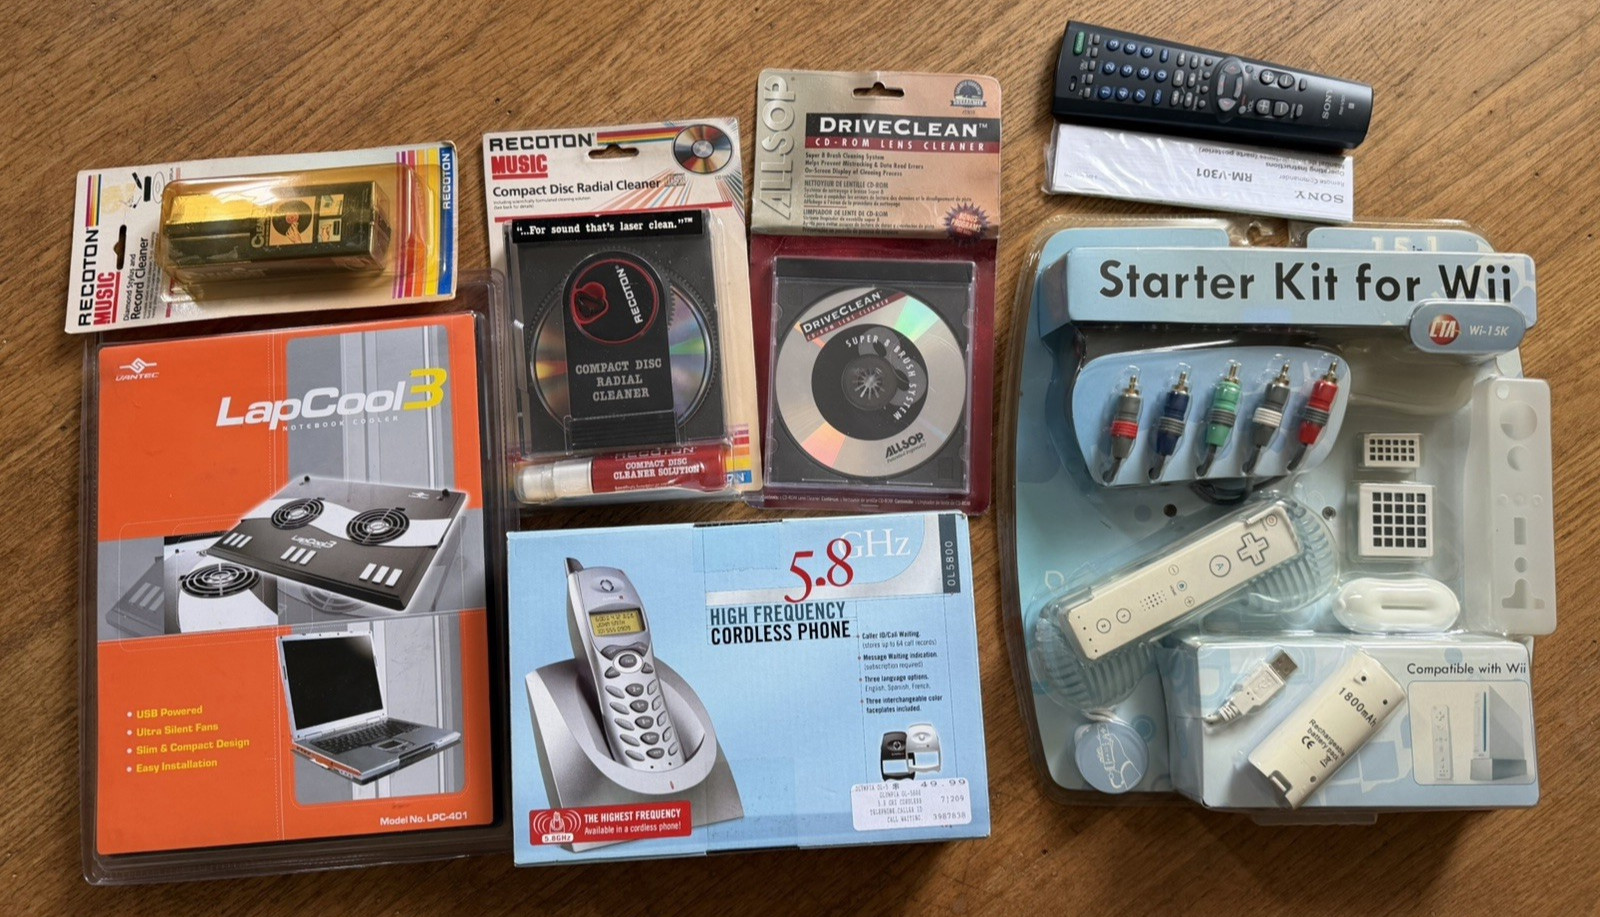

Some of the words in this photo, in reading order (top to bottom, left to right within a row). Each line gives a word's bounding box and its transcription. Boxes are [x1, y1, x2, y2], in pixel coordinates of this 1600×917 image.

[490, 132, 592, 152] RECOTON
[760, 75, 796, 220] ALLSOP
[880, 139, 913, 150] LENS
[923, 140, 985, 152] CLEANER
[491, 154, 548, 174] MUSIC
[832, 168, 852, 176] Display
[1265, 161, 1308, 172] Instructions
[1308, 165, 1345, 177] Operating
[442, 153, 451, 210] RECOTON
[1196, 167, 1253, 183] RM-V301
[1279, 174, 1319, 185] Commander
[492, 182, 547, 198] Compact
[550, 180, 574, 195] Disc
[577, 178, 614, 193] Radial
[616, 178, 662, 191] Cleaner
[1321, 180, 1345, 188] Remote
[1294, 190, 1344, 204] SONY
[551, 222, 580, 234] sound
[586, 221, 615, 232] that's
[620, 220, 643, 232] laser
[136, 237, 149, 279] Cleaner
[78, 228, 99, 326] RECOTON
[126, 265, 135, 289] Stylus
[1099, 259, 1255, 300] Starter
[1275, 262, 1338, 301] Kit
[1356, 263, 1420, 302] for
[1438, 264, 1512, 303] Wii
[93, 272, 115, 326] MUSIC
[130, 282, 145, 320] Record
[616, 267, 644, 324] RECOTON
[122, 290, 133, 322] Diamond
[1469, 325, 1510, 337] Wi-15K
[845, 334, 880, 348] SUPER
[575, 360, 630, 375] COMPACT
[635, 358, 662, 370] DISC
[893, 345, 917, 378] BRUSH
[115, 372, 160, 382] VANTEC
[596, 374, 643, 388] RADIAL
[216, 368, 448, 430] LapCool3
[592, 388, 650, 402] CLEANER
[892, 382, 917, 421] SYSTEM
[282, 420, 346, 432] NOTEBOOK
[352, 416, 399, 426] COOLER
[885, 432, 924, 459] ALLSOP
[613, 468, 656, 480] CLEANER
[658, 464, 700, 477] SOLUTION
[625, 459, 665, 470] COMPACT
[668, 458, 688, 466] DISC
[784, 537, 854, 604] 5.8
[837, 528, 911, 559] GHz
[944, 540, 956, 586] OL5800
[710, 606, 748, 626] HIGH
[754, 601, 846, 624] FREQUENCY
[711, 624, 792, 646] CORDLESS
[798, 620, 851, 640] PHONE
[862, 632, 878, 640] Caller
[916, 638, 938, 646] records)
[863, 654, 888, 662] Message
[1406, 662, 1474, 677] Compatible
[1478, 662, 1502, 674] with
[1506, 662, 1526, 674] Wii
[882, 696, 927, 704] interchangeable
[928, 694, 943, 702] color
[136, 708, 158, 719] USB
[160, 705, 203, 717] Powered
[866, 706, 896, 714] faceplates
[1338, 687, 1377, 728] 1800mAh
[136, 728, 162, 737] Ultra
[164, 724, 193, 735] Silent
[196, 722, 218, 732] Fans
[136, 746, 158, 755] Slim
[160, 744, 168, 753] &
[170, 741, 214, 753] Compact
[216, 738, 250, 749] Design
[1306, 727, 1328, 750] battery
[1326, 747, 1340, 761] pack
[136, 763, 160, 774] Easy
[162, 758, 218, 771] Installation
[920, 778, 966, 788] 49.99
[380, 816, 409, 826] Model
[410, 814, 426, 824] No.
[426, 811, 468, 822] LPC-401
[584, 814, 599, 824] THE
[600, 812, 634, 823] HIGHEST
[636, 808, 682, 821] FREQUENCY
[584, 825, 614, 836] Available
[616, 824, 623, 834] in
[624, 825, 628, 833] a
[630, 822, 658, 832] cordless
[658, 821, 682, 832] phone!
